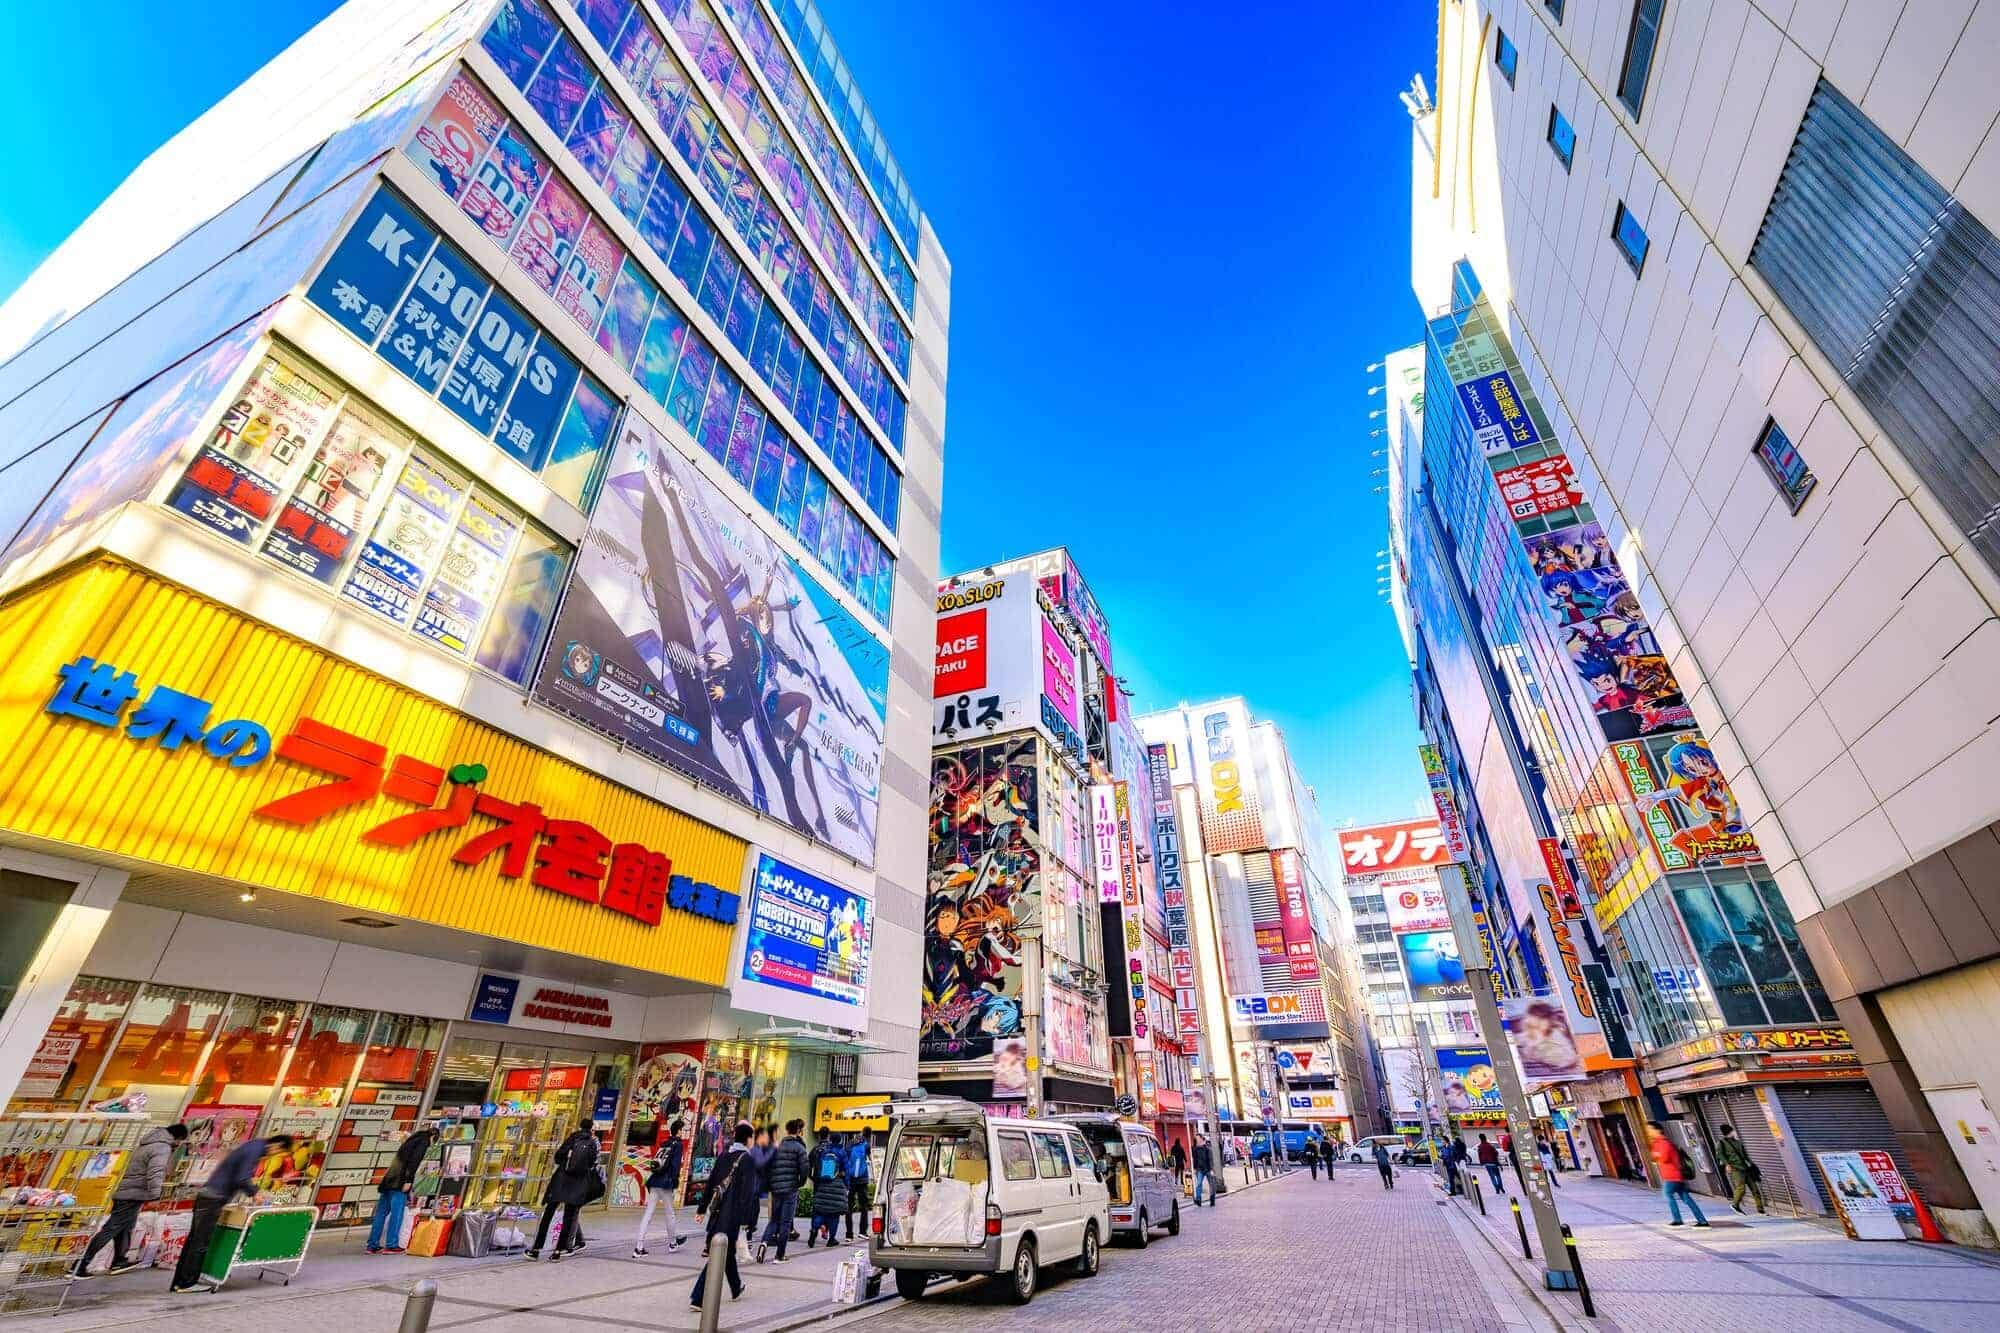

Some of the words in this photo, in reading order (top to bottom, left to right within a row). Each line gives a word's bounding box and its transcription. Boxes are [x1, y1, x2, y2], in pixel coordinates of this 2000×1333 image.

[367, 213, 557, 395] K-BOOKS
[404, 298, 504, 393] 秋葉原
[1490, 378, 1529, 442] お部屋探しは
[1482, 436, 1505, 450] 7F
[1515, 503, 1534, 515] 6F
[599, 682, 658, 718] アークナイツ
[933, 695, 1003, 736] パス
[44, 655, 273, 768] 世界の
[253, 717, 673, 928] ラジオ会館
[752, 954, 763, 968] 2F
[1429, 986, 1472, 995] TOKYO
